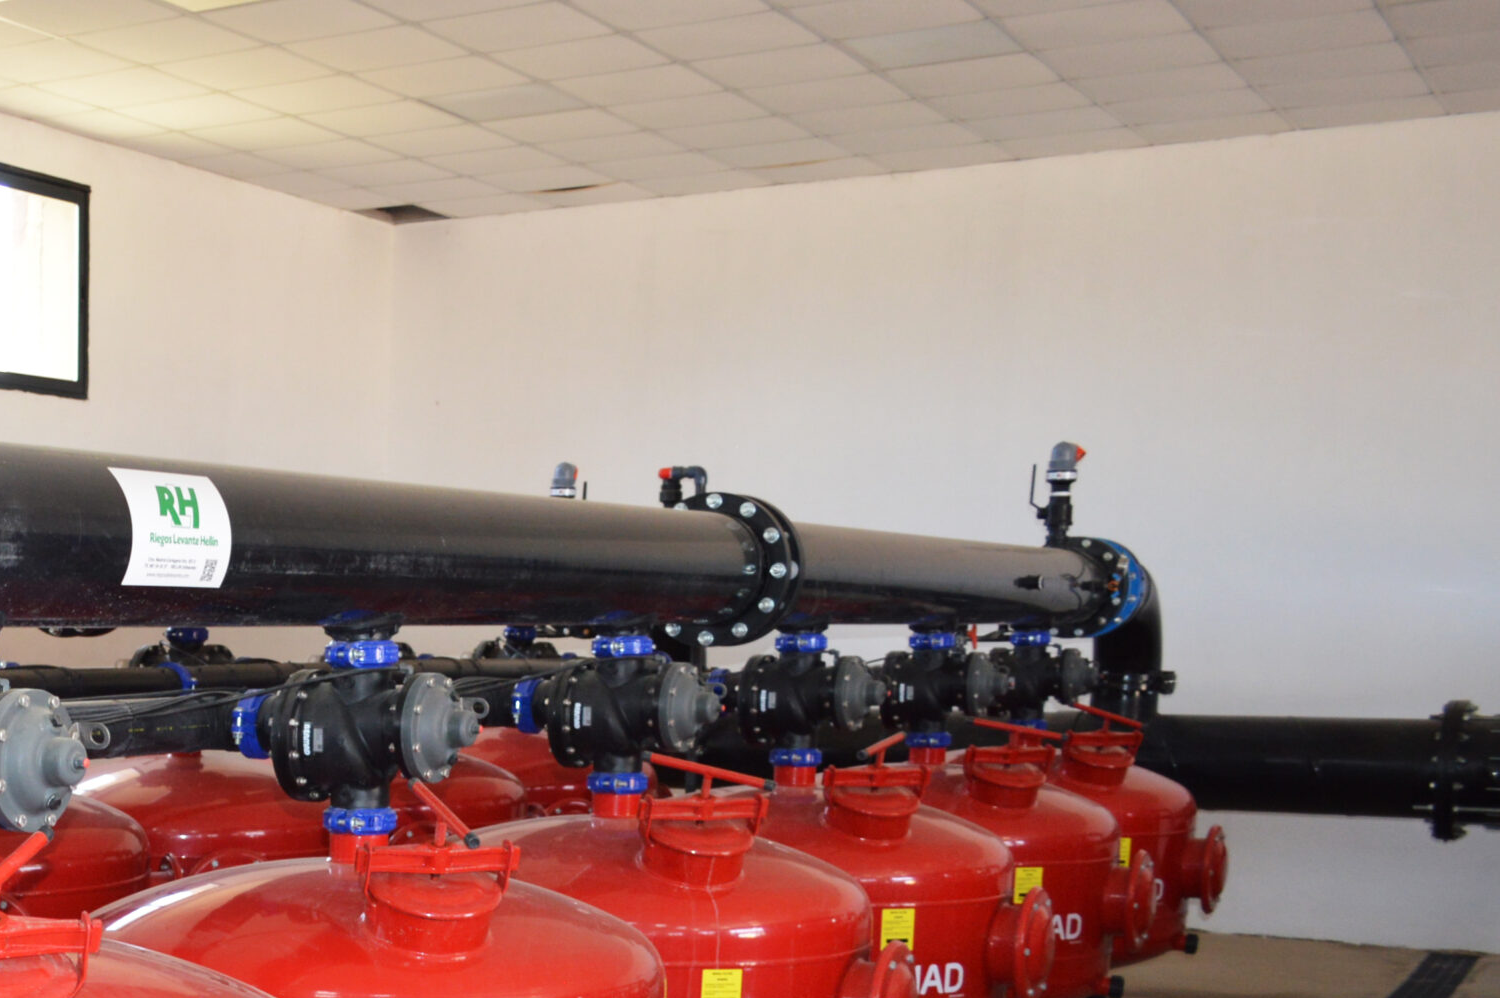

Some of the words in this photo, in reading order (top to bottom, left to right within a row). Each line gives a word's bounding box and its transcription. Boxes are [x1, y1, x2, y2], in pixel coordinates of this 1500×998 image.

[155, 485, 200, 529] RH
[149, 532, 172, 547] Riegos
[173, 534, 199, 546] Levante
